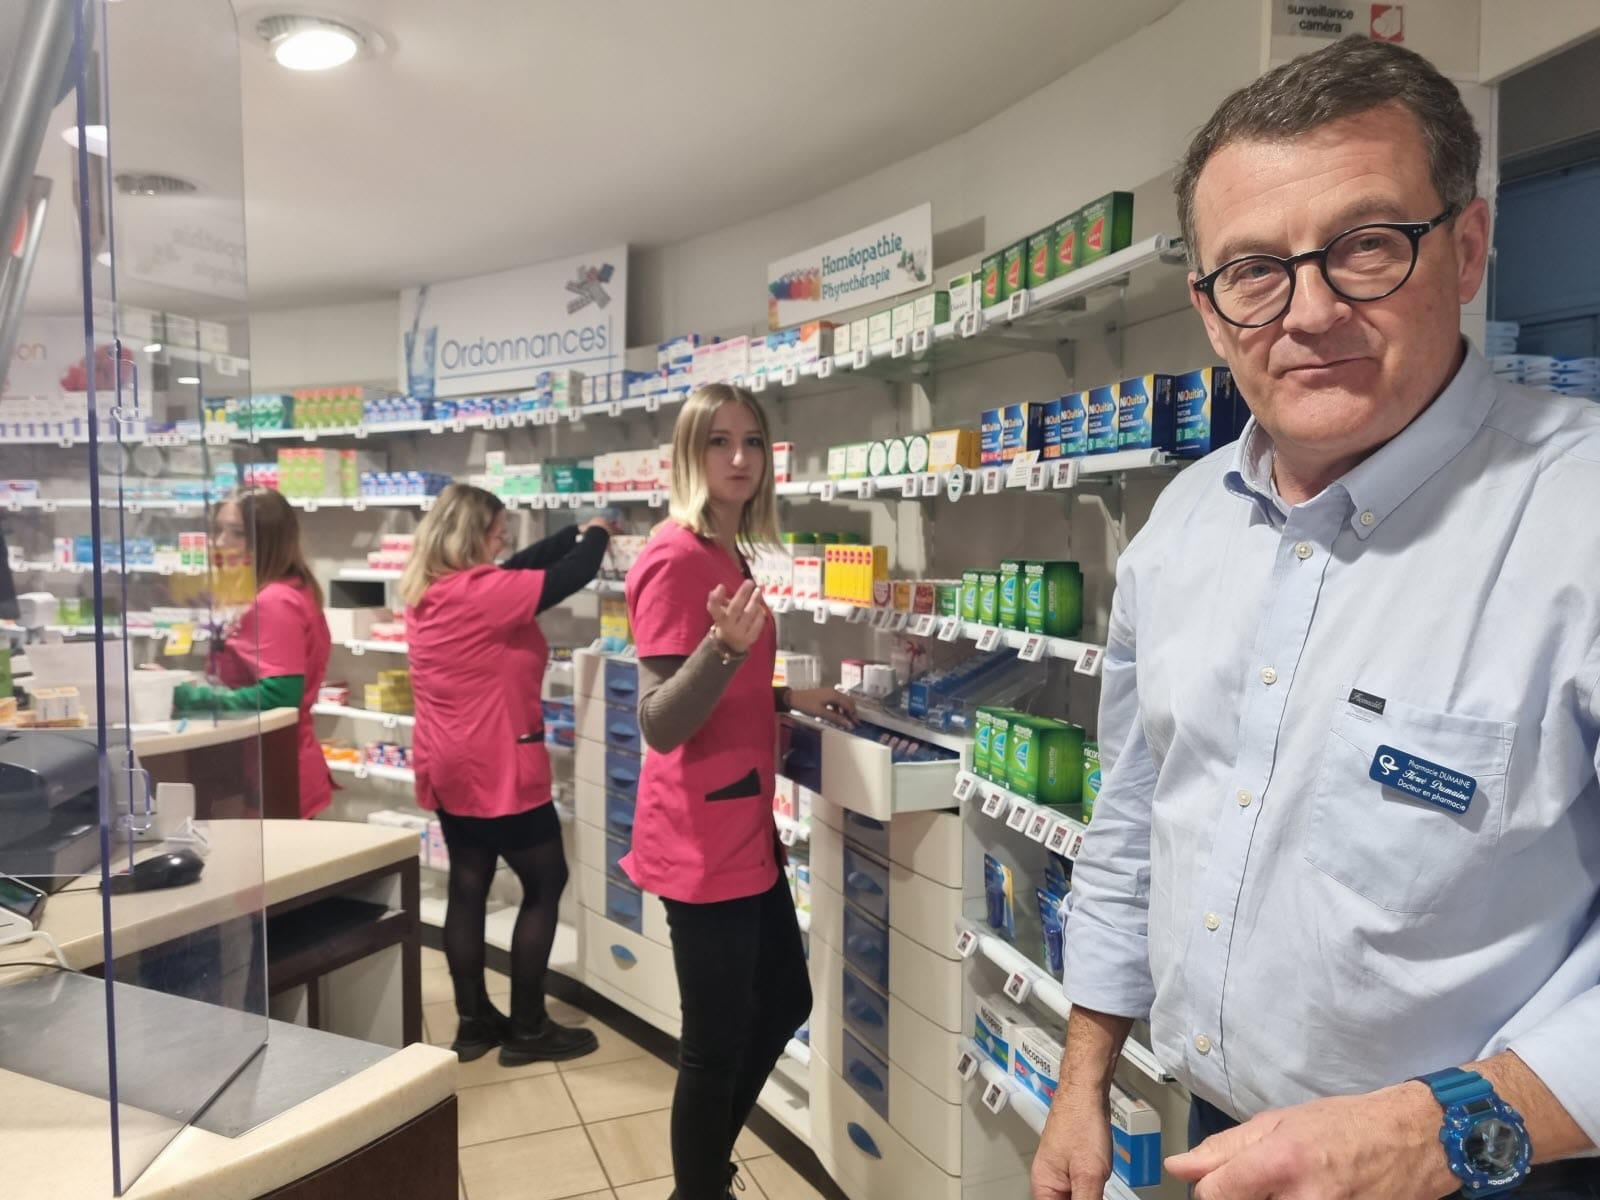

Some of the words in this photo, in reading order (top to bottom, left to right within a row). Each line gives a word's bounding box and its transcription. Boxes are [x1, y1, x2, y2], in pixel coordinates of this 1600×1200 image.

[1287, 4, 1354, 20] surveillance
[1299, 19, 1342, 33] caméra
[821, 232, 902, 278] Homéopathie
[821, 267, 890, 301] Phytothérapie
[441, 323, 608, 370] Ordonnances
[1119, 394, 1147, 408] NiQuitin
[1177, 388, 1204, 402] NiQuitin
[1061, 408, 1084, 420] NiQuitin
[1088, 402, 1113, 414] NiQuitin
[1408, 759, 1439, 777] Pharmacie
[1439, 771, 1471, 788] DUMAINE
[1397, 778, 1422, 793] Docteur
[1422, 789, 1431, 798] en
[1431, 793, 1467, 812] pharmacie
[1430, 779, 1470, 801] Dumaine
[1022, 1042, 1051, 1073] Nicopass
[1487, 1171, 1520, 1186] G-SHOCK
